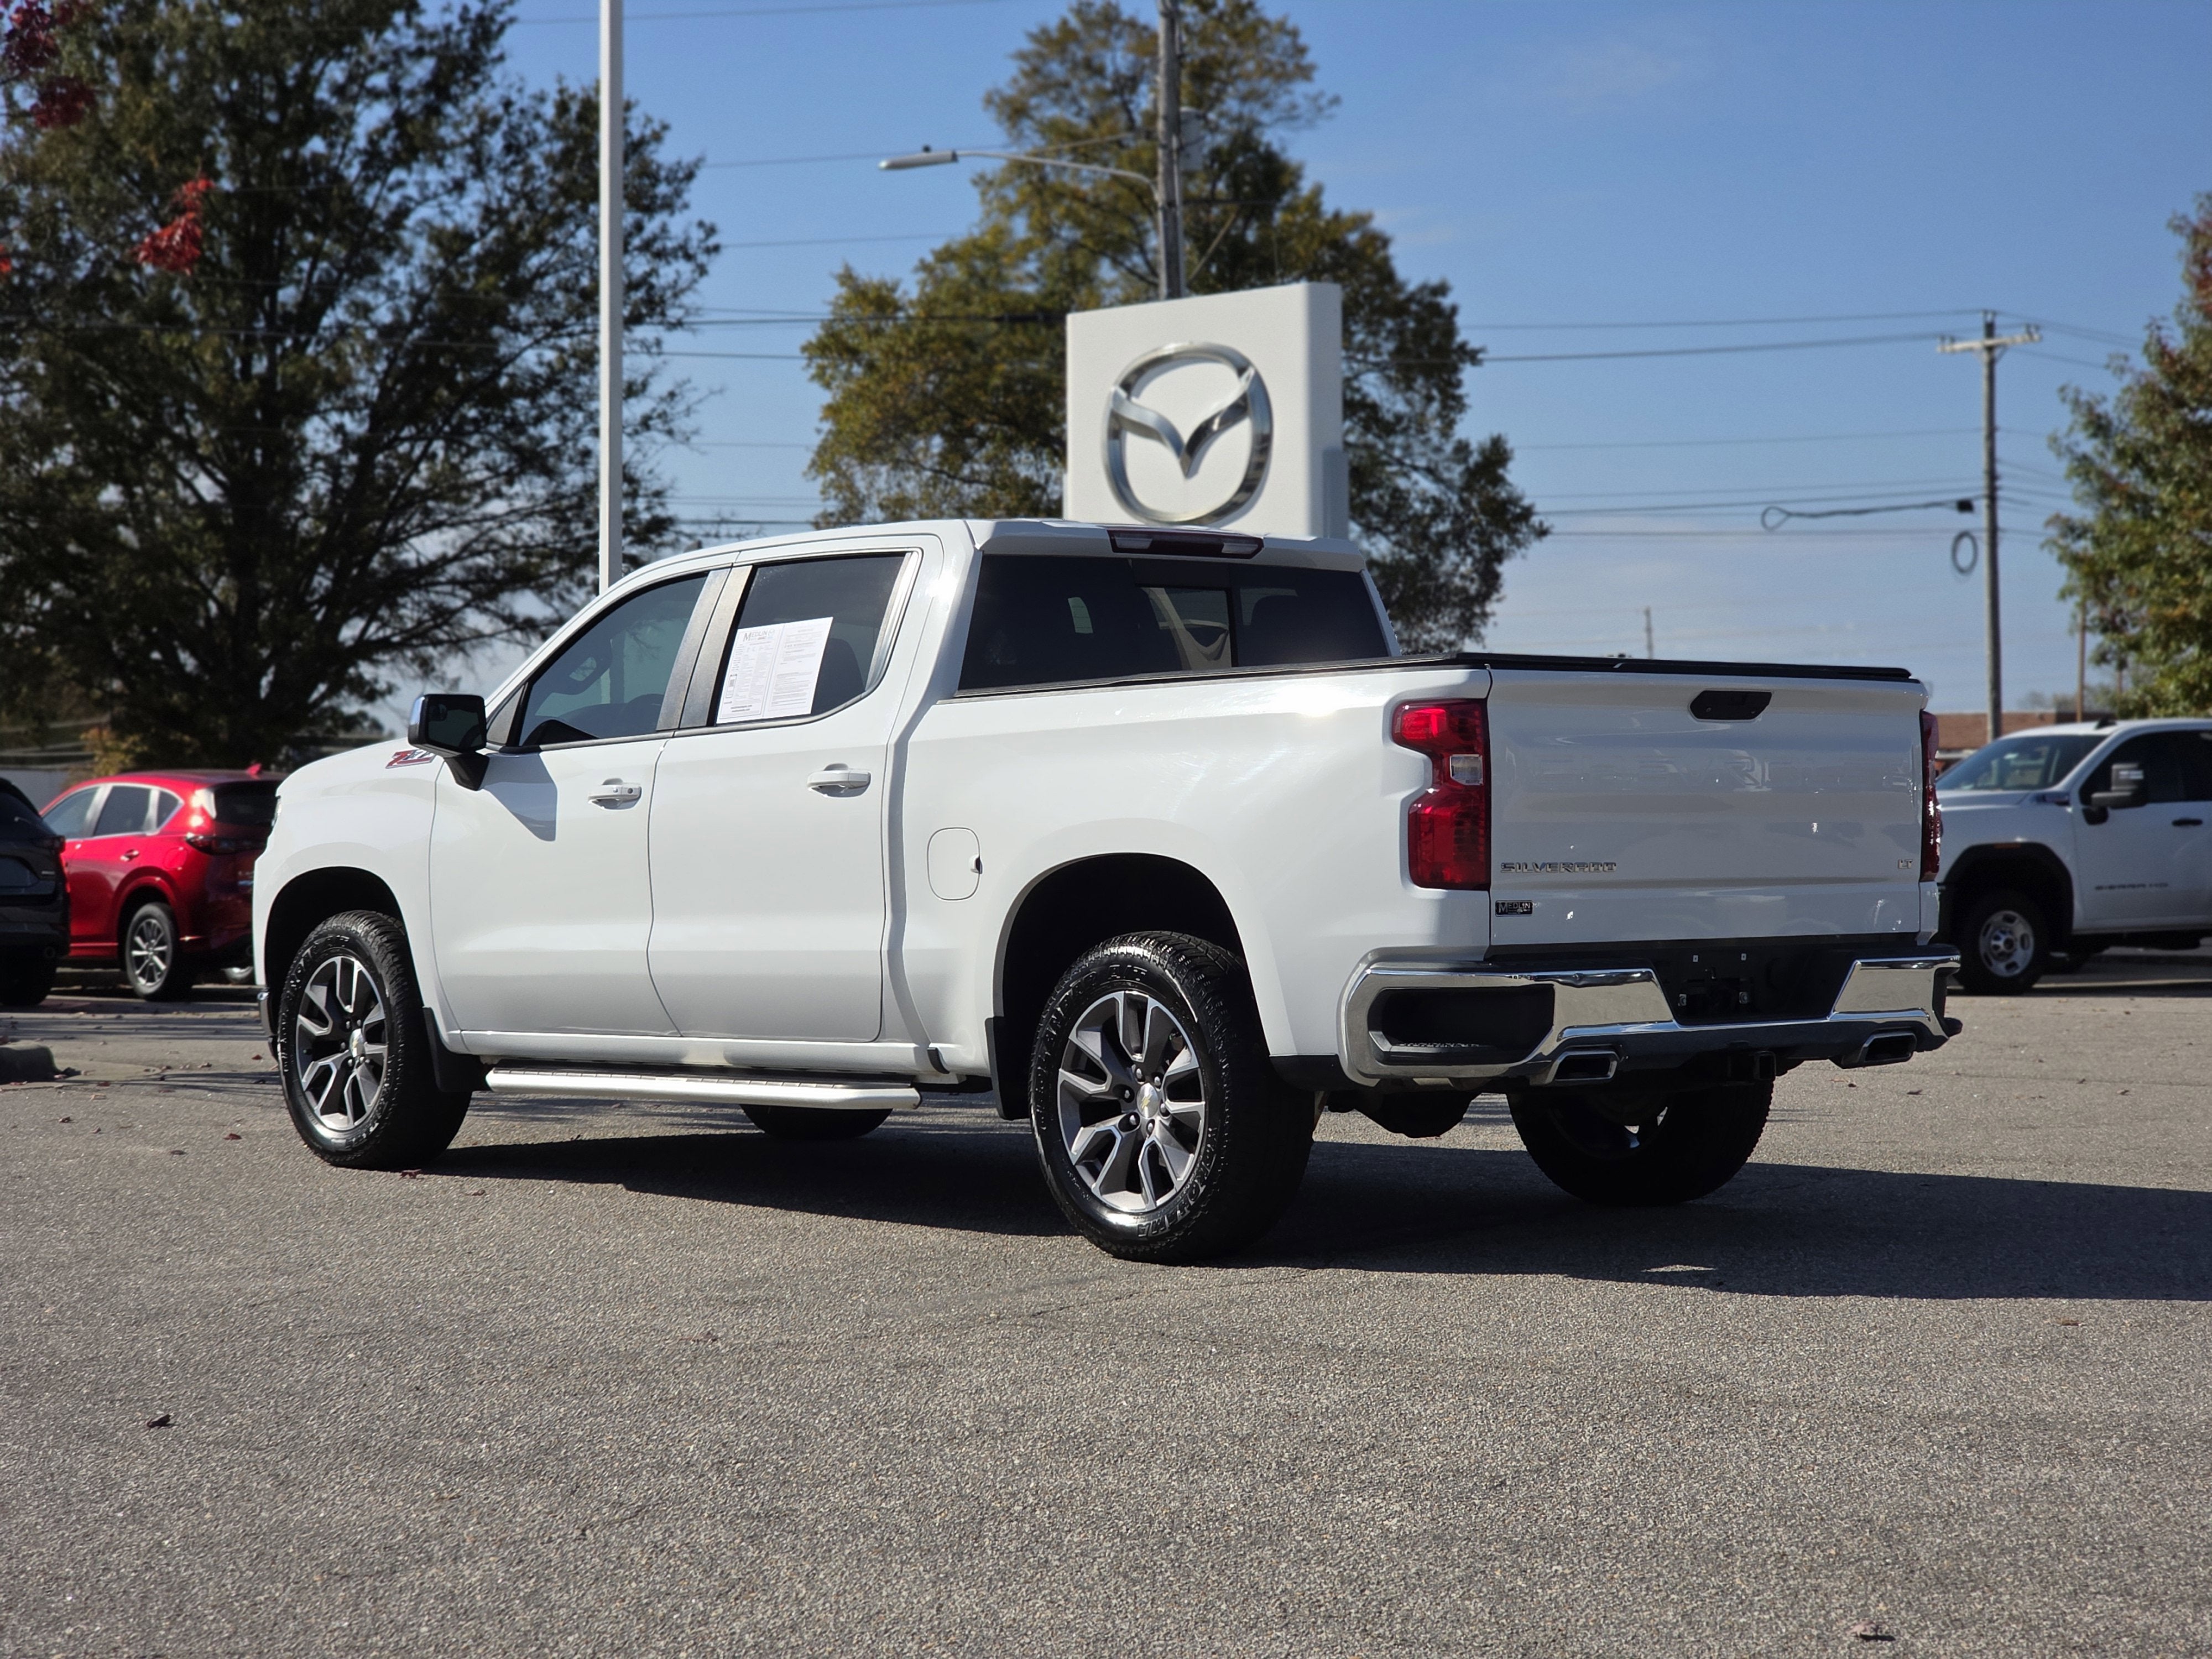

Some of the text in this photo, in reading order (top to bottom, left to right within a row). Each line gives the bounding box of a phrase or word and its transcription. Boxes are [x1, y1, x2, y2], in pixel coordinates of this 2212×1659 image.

[1500, 862, 1617, 873] SILVERADO
[1897, 858, 1913, 869] LT
[1499, 902, 1531, 913] MEDLIN
